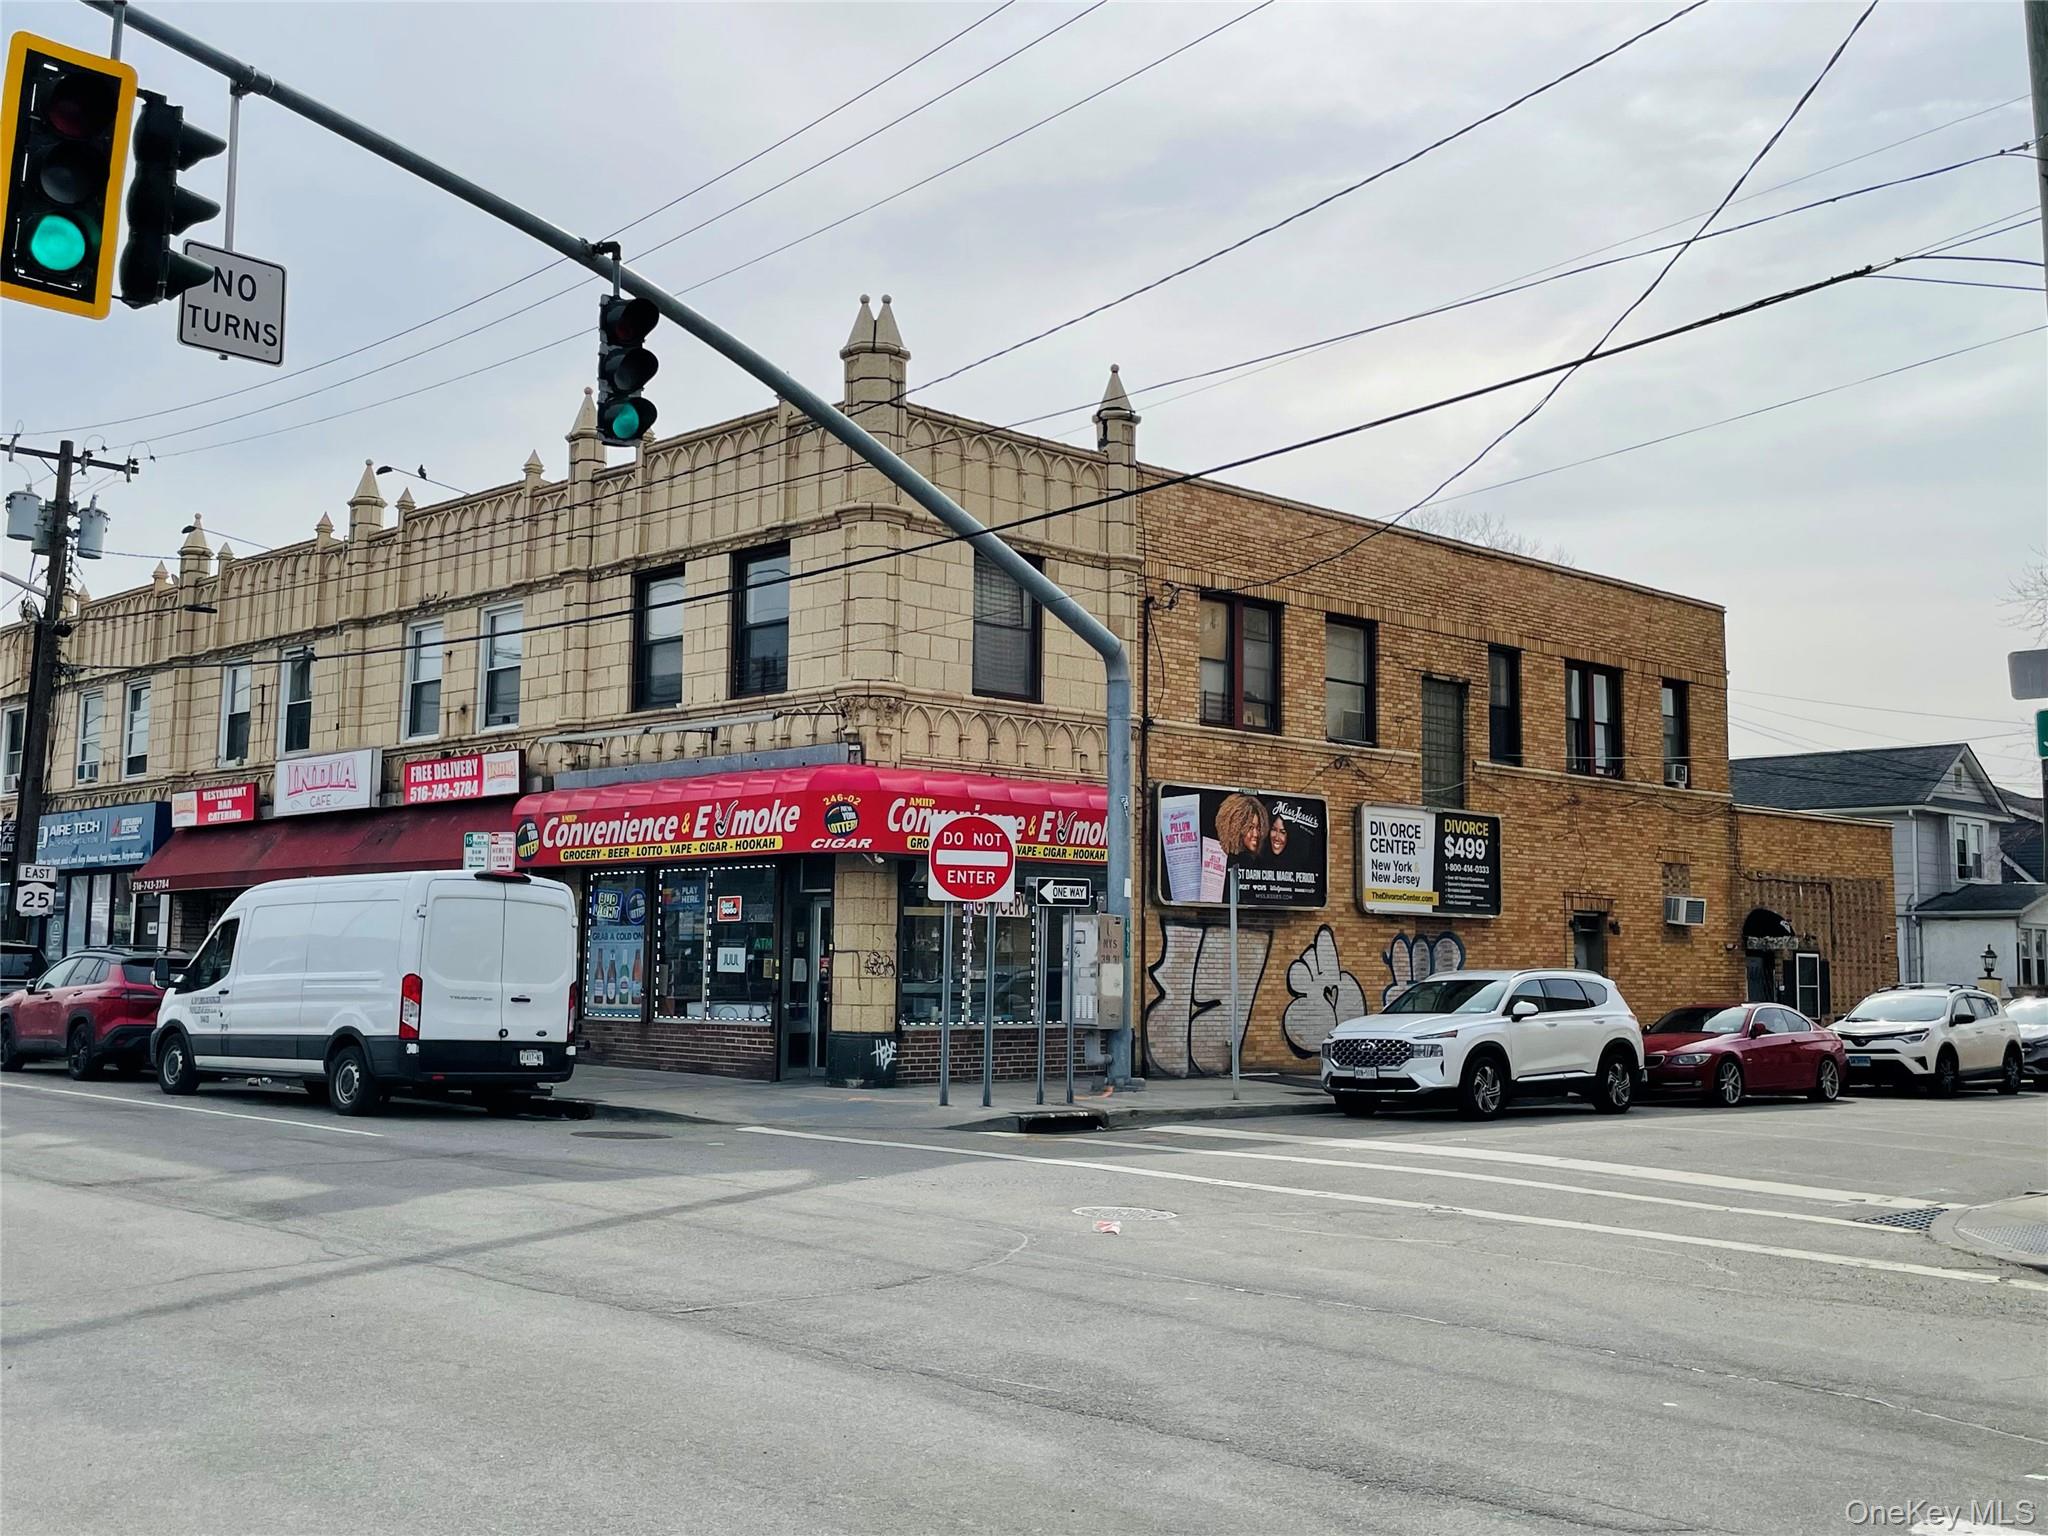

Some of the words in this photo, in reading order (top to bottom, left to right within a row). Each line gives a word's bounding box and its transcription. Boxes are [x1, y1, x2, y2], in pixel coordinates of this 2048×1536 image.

[213, 266, 257, 302] NO
[187, 304, 278, 347] TURNS
[287, 758, 359, 797] INDIA
[410, 764, 432, 783] FREE
[434, 759, 478, 780] DELIVERY
[203, 787, 247, 801] RESTAURANT
[410, 780, 479, 802] 516-743-3784
[217, 800, 232, 810] BAR
[310, 794, 332, 807] CAFE
[823, 794, 862, 806] 246-02
[208, 809, 242, 822] CATERING
[1272, 801, 1294, 817] Miss
[50, 824, 72, 837] AIRE
[74, 820, 101, 834] TECH
[543, 812, 678, 848] Convenience
[681, 813, 690, 834] &
[1028, 815, 1037, 836] &
[1370, 821, 1422, 839] DIVORCE
[1444, 818, 1489, 837] DIVORCE
[811, 838, 872, 849] CIGAR
[943, 831, 964, 846] DO
[973, 833, 1003, 847] NOT
[563, 850, 601, 860] GROCERY
[608, 848, 629, 858] BEER
[637, 846, 662, 856] LOTTO
[670, 843, 692, 854] VAPE
[700, 841, 727, 853] CIGAR
[735, 838, 776, 850] HOOKAH
[1017, 846, 1037, 857] VAPE
[1043, 847, 1067, 858] CIGAR
[1073, 849, 1105, 860] HOOKAH
[1370, 838, 1416, 855] CENTER
[25, 867, 51, 879] EAST
[1371, 859, 1391, 871] New
[1393, 860, 1413, 873] York
[1444, 862, 1490, 874] 1-800-414-0333
[947, 870, 996, 884] ENTER
[1246, 869, 1260, 880] DARN
[1262, 870, 1275, 881] CURL
[1371, 871, 1391, 883] New
[1392, 873, 1420, 888] Jersey
[682, 886, 699, 895] PLAY
[1052, 886, 1067, 898] ONE
[1069, 887, 1085, 898] WAY
[1371, 891, 1434, 902] TheDivorceCenter.com
[22, 891, 50, 908] 25
[599, 892, 618, 906] BUD
[682, 895, 701, 903] HERE
[593, 904, 621, 919] LIGHT
[592, 932, 609, 941] GRAB
[616, 932, 632, 941] COLD
[754, 937, 773, 950] ATM
[1102, 939, 1118, 949] NYS
